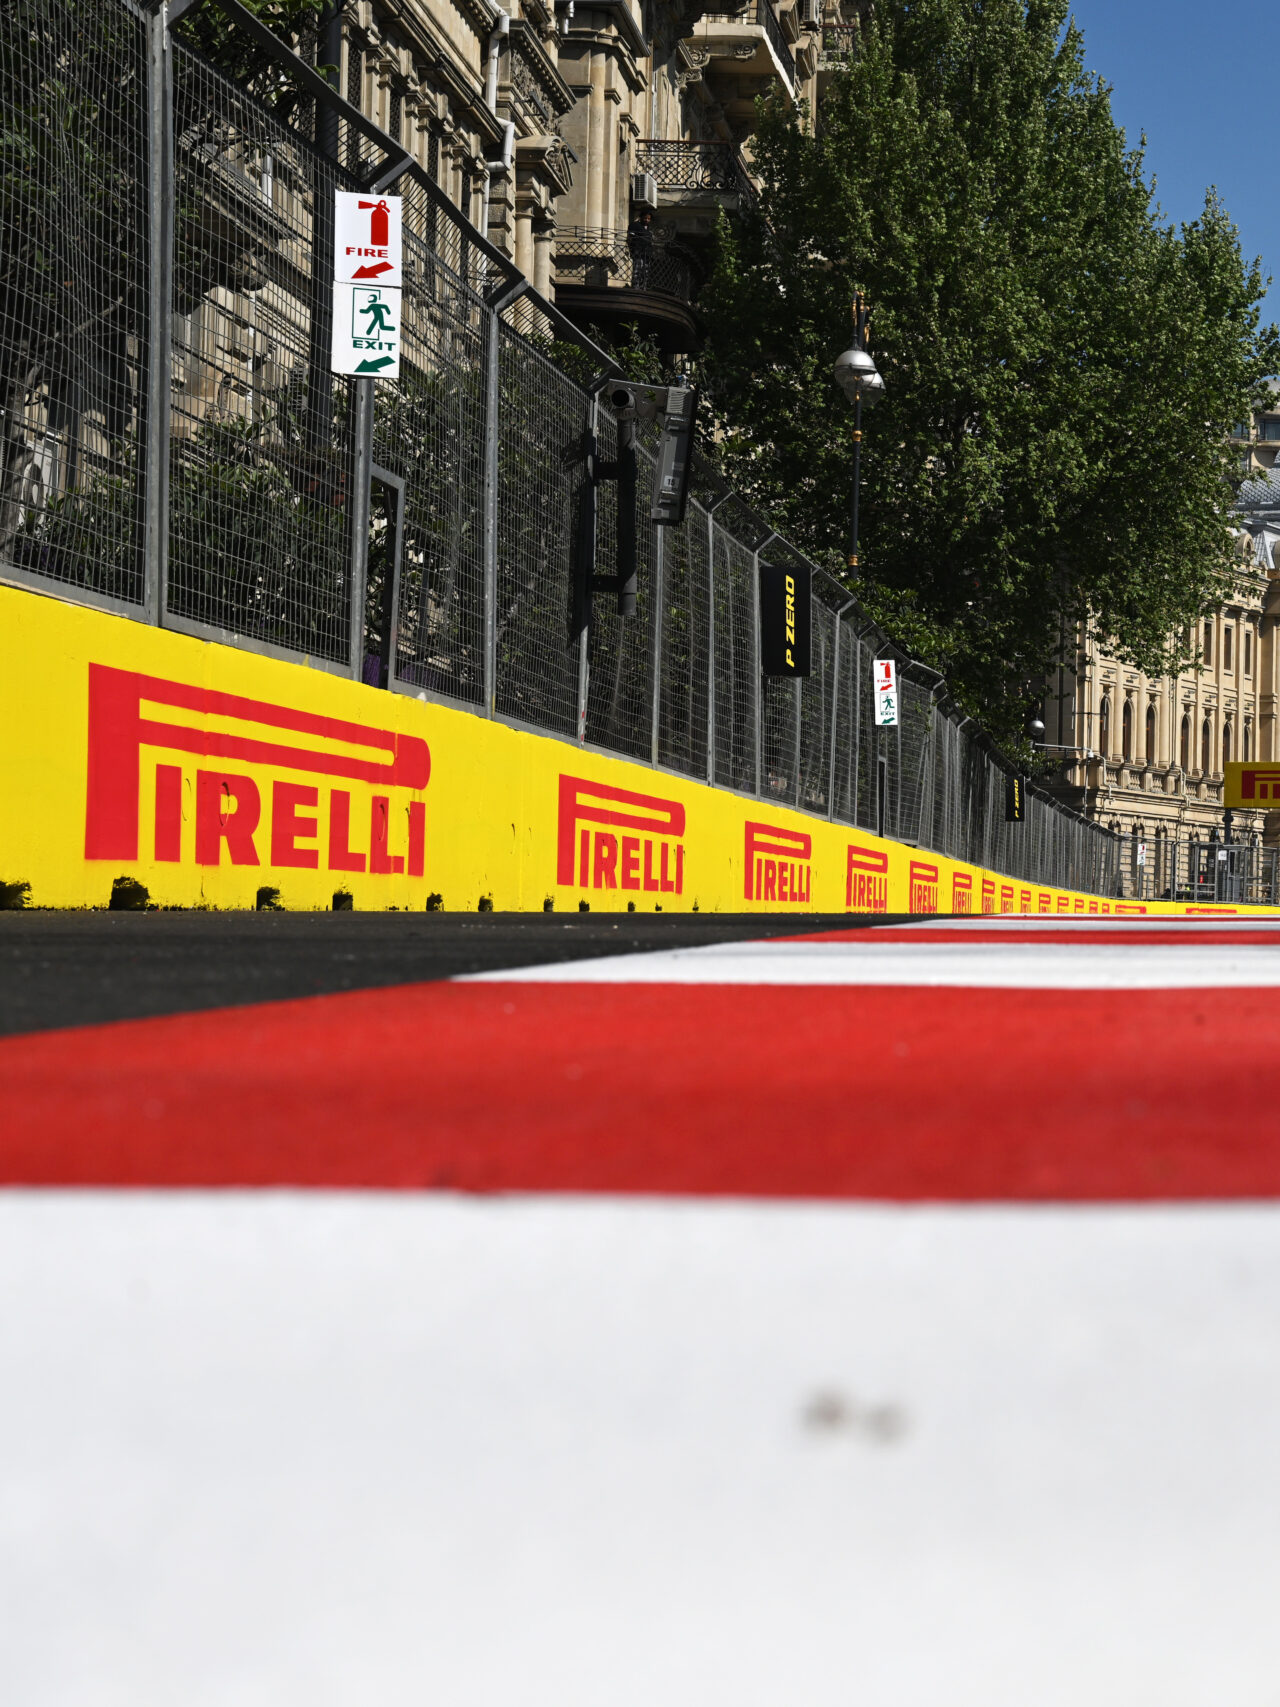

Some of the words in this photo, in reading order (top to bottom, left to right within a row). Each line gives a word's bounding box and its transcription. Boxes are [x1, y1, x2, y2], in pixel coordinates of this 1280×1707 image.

[345, 247, 389, 258] FIRE
[352, 340, 396, 351] EXIT
[785, 574, 795, 646] ZERO
[785, 648, 795, 668] P
[84, 663, 432, 876] PIRELLI
[557, 774, 685, 895] PIRELLI
[744, 821, 811, 903] PIRELLI
[846, 845, 888, 907] PIRELLI
